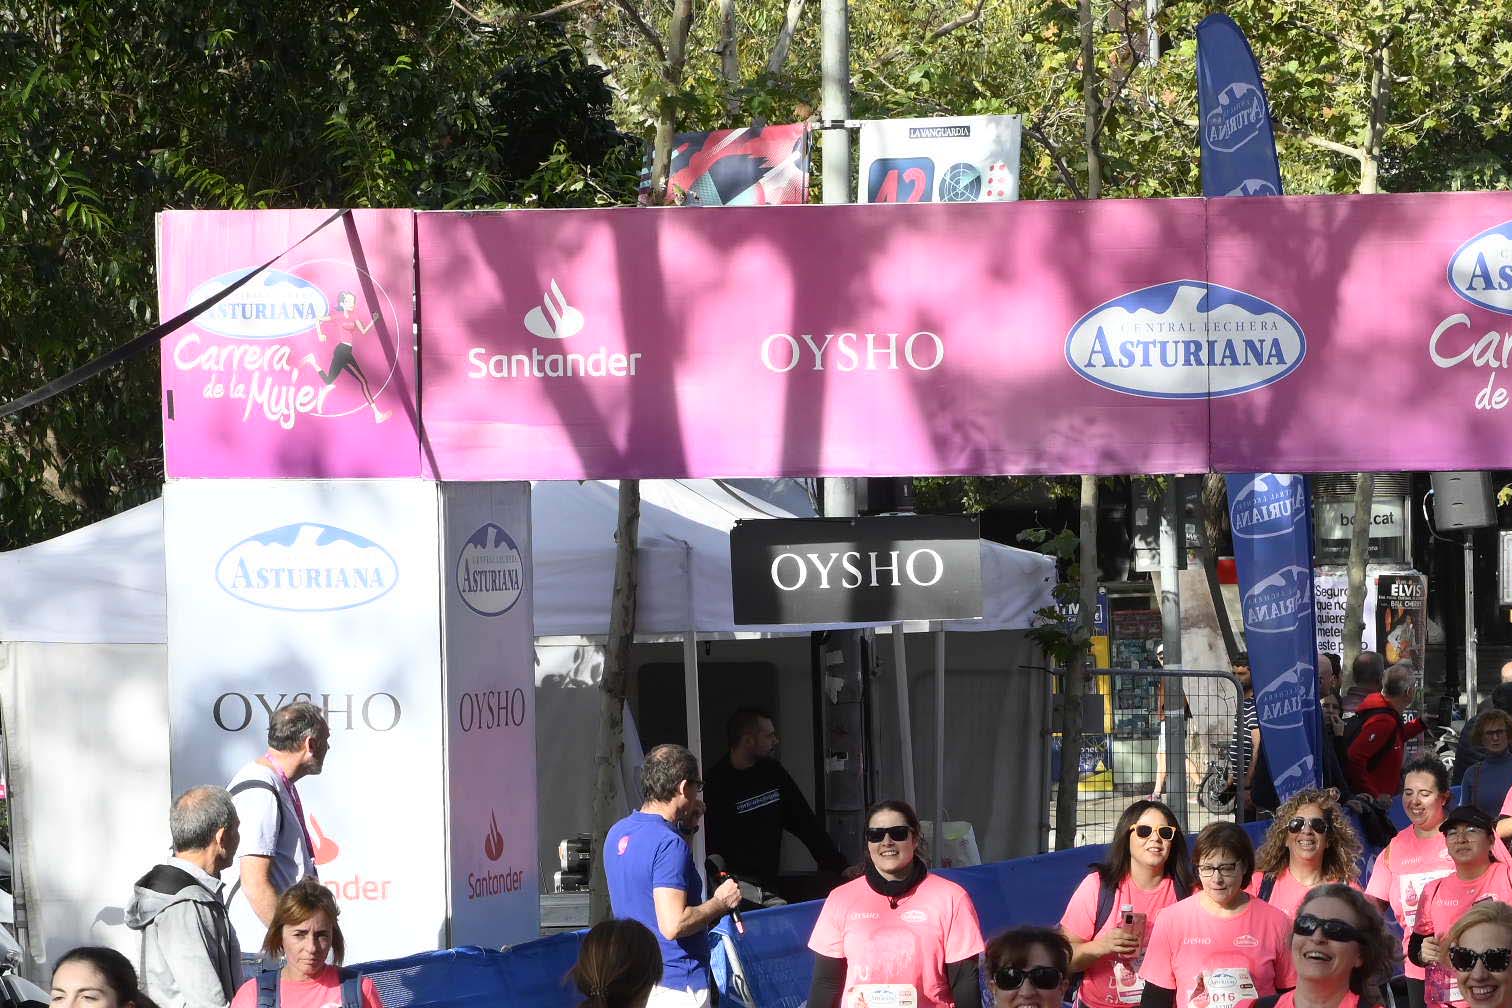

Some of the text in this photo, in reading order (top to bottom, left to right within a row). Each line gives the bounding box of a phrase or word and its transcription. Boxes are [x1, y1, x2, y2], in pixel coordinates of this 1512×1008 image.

[910, 127, 969, 137] LA VANGUARDIA
[1121, 320, 1279, 333] CENTRAL LECHERA
[174, 333, 291, 371] Carrera
[468, 347, 642, 378] Santander
[761, 332, 944, 373] OYSHO
[1084, 326, 1287, 368] ASTURIANA
[203, 375, 246, 398] de la
[243, 366, 336, 429] Mujer
[1475, 372, 1510, 410] de
[232, 557, 386, 590] ASTURIANA
[462, 557, 520, 593] ASTURIANA
[771, 549, 944, 590] OYSHO
[1316, 601, 1333, 611] que
[1391, 585, 1421, 596] ELVIS
[1318, 641, 1337, 650] este
[213, 692, 401, 731] OYHO
[459, 688, 525, 732] OYSHO
[468, 866, 523, 899] Santander
